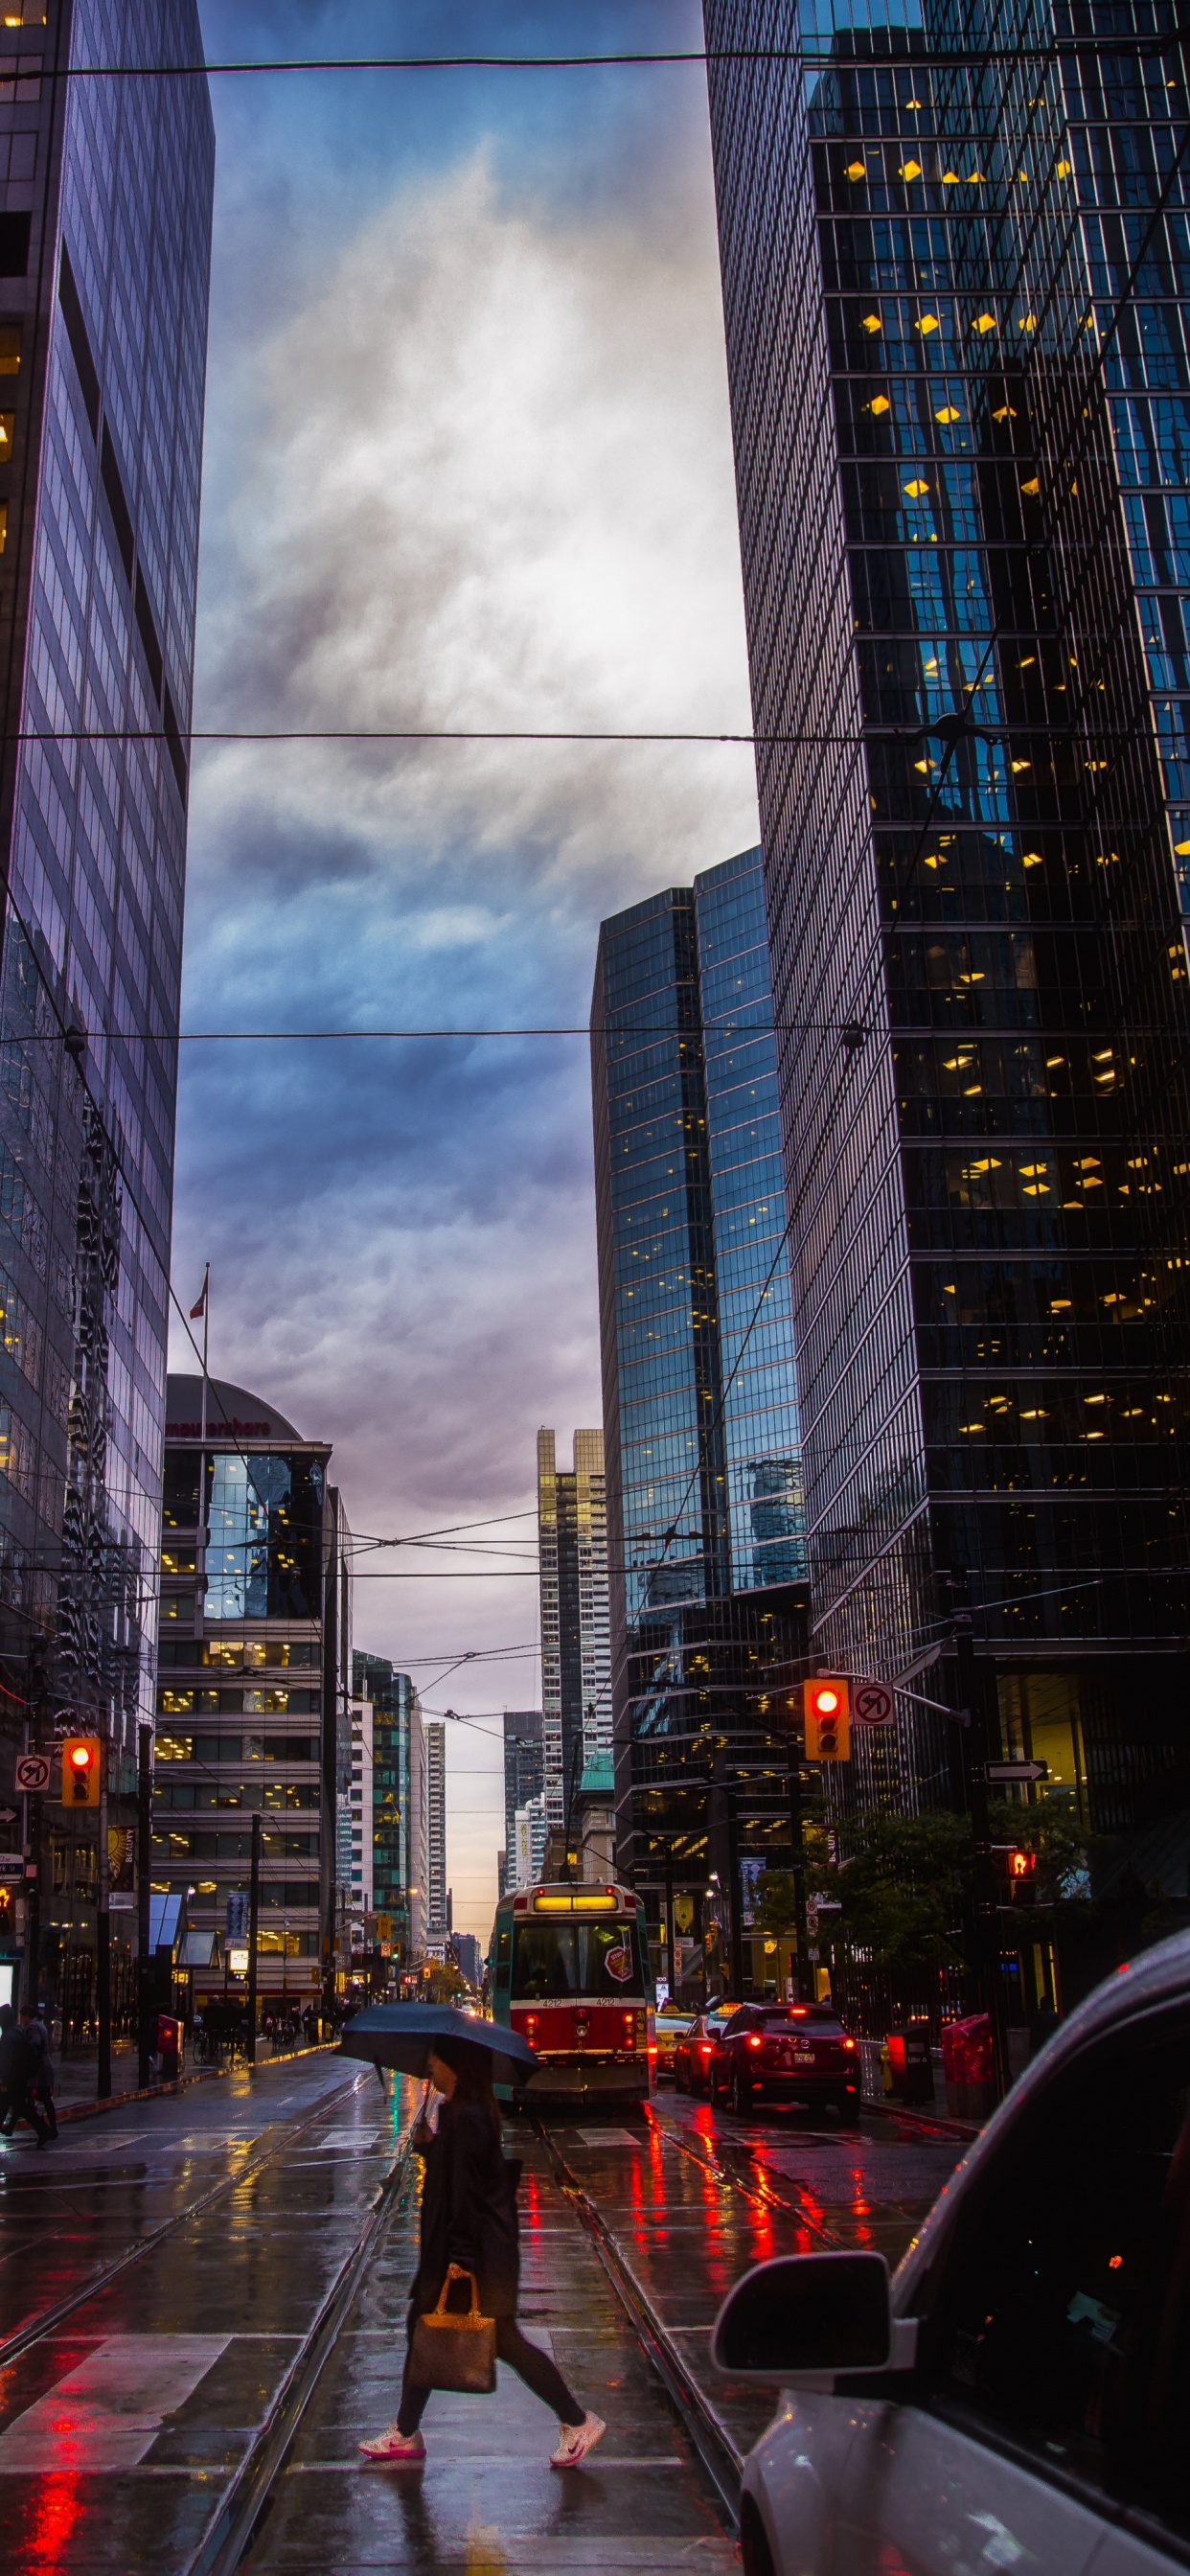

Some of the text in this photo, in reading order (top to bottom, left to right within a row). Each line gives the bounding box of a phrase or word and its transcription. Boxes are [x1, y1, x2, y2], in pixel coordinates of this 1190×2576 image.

[165, 1417, 270, 1438] mpuershare
[126, 1828, 134, 1863] BEAUTY
[610, 1951, 623, 1960] STOP
[543, 1999, 562, 2008] 4212
[596, 1998, 615, 2007] 4212
